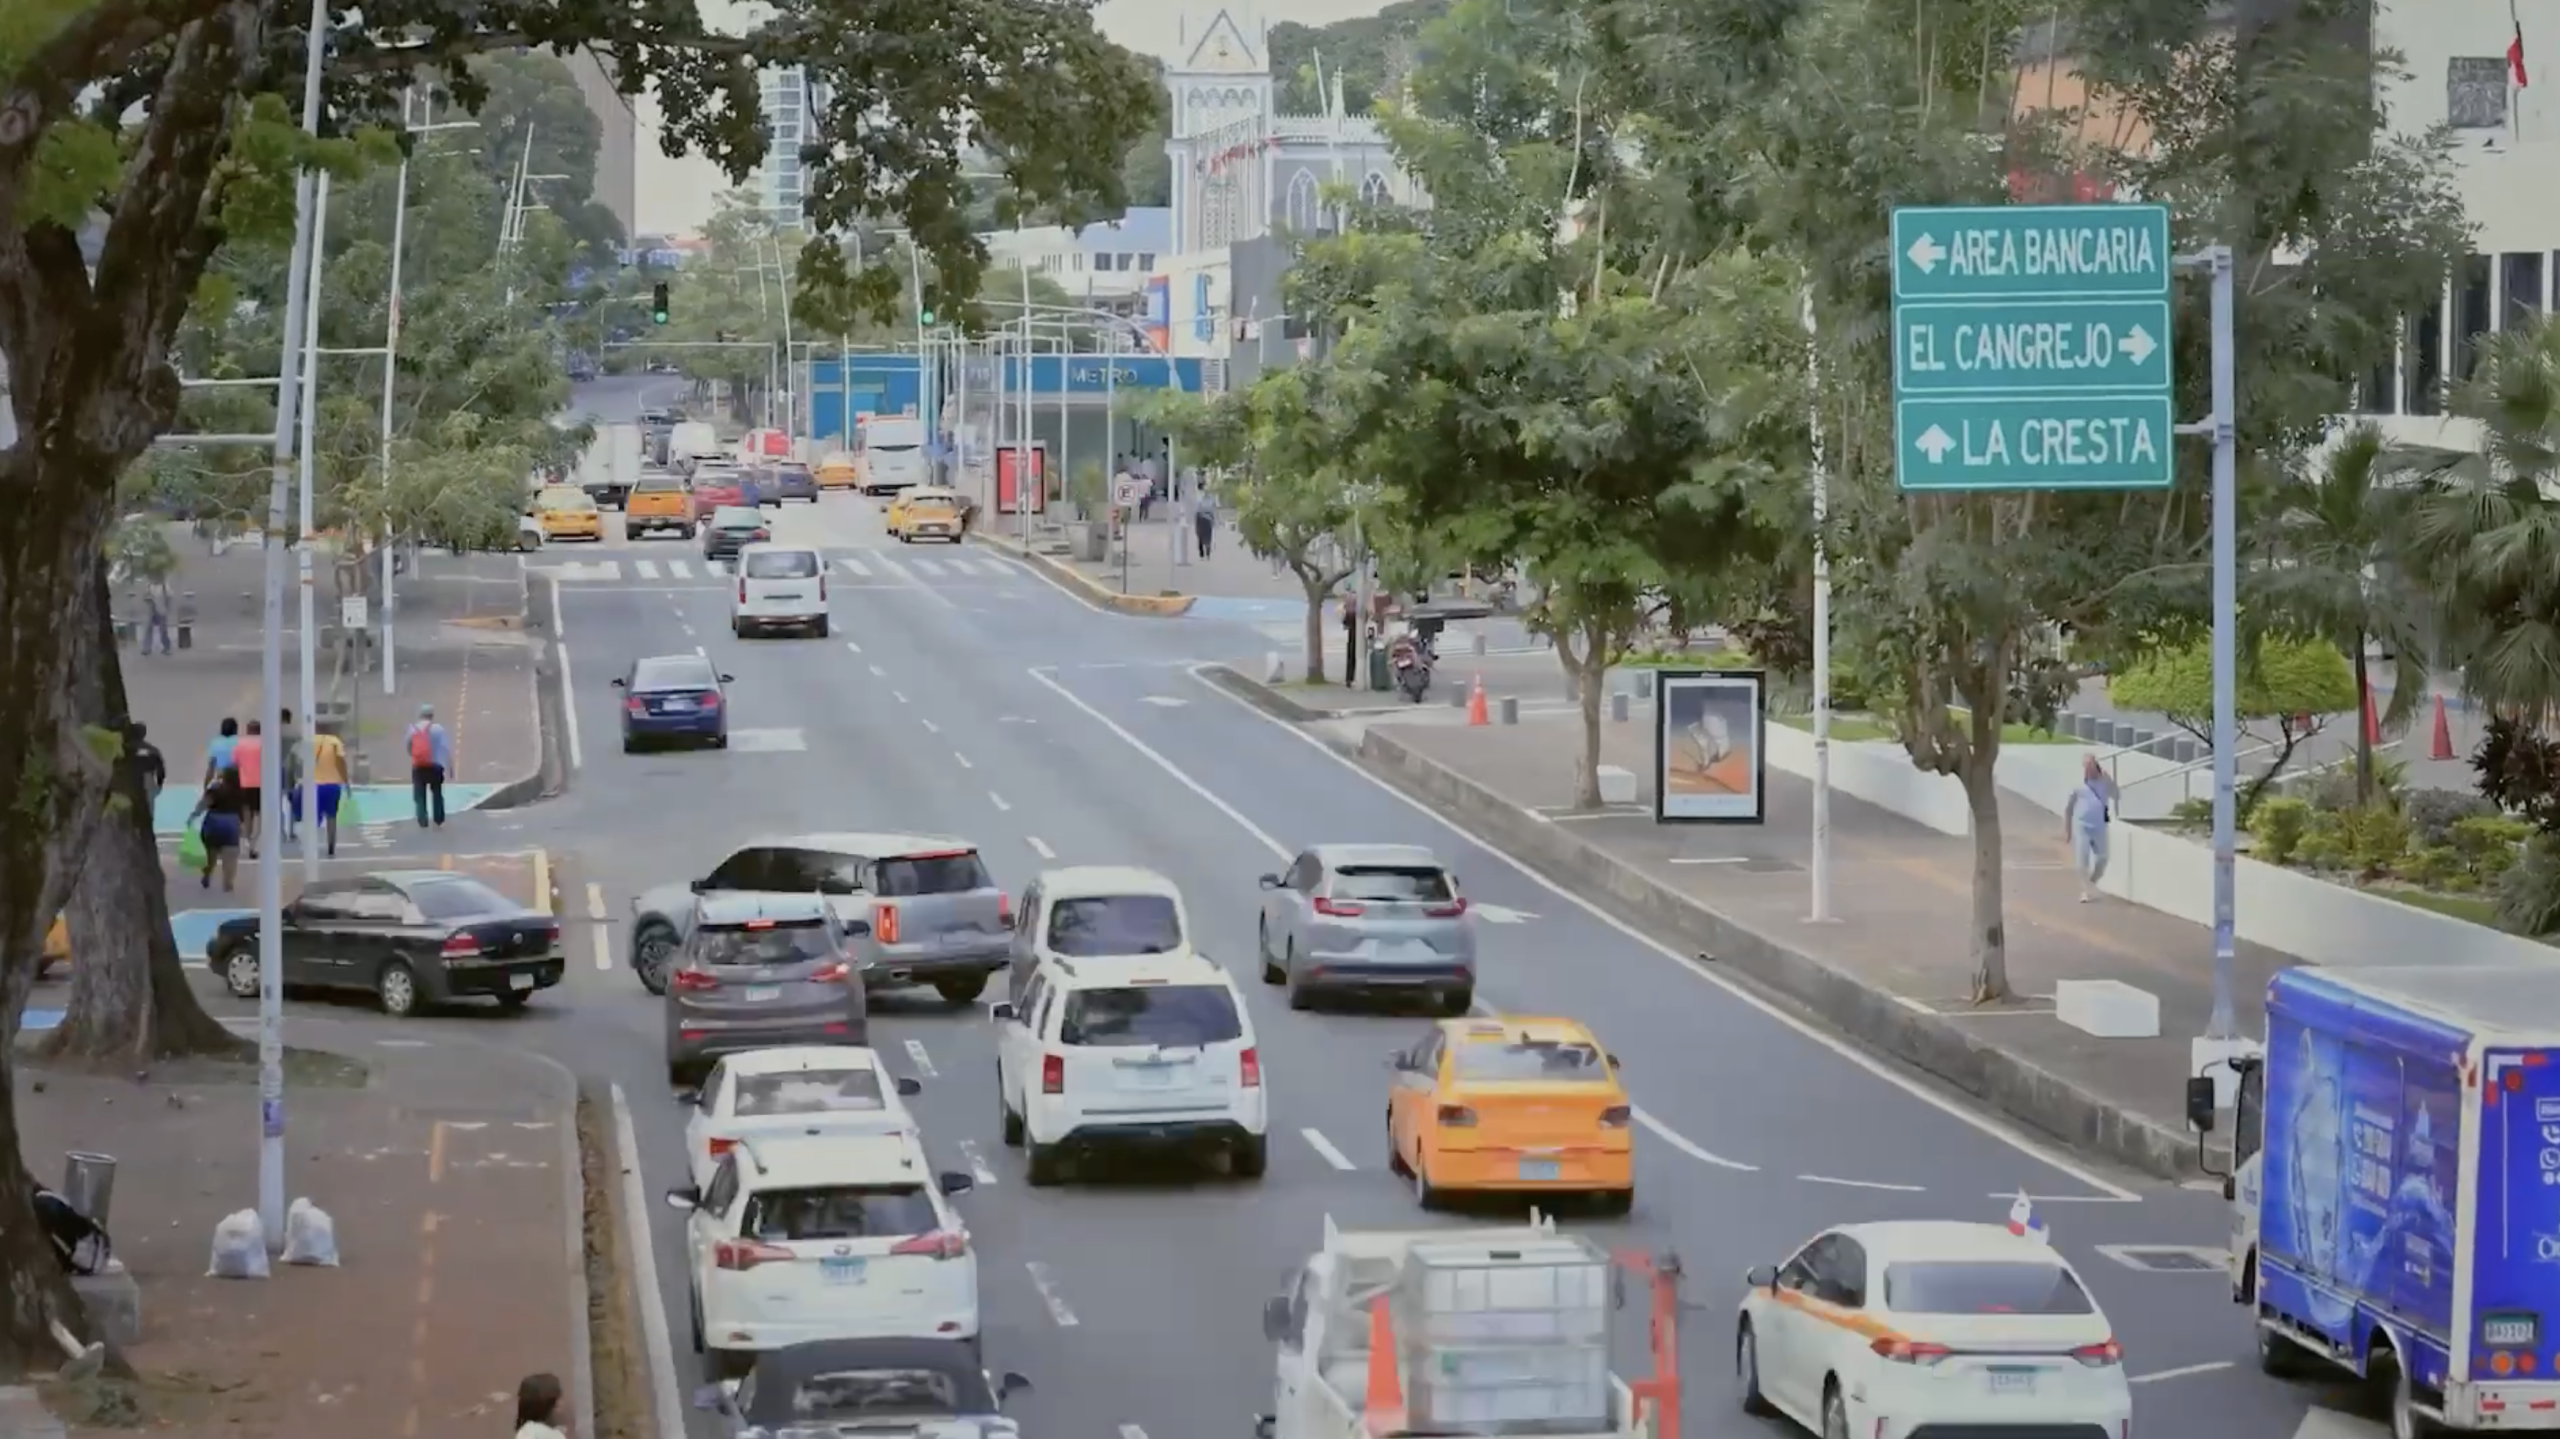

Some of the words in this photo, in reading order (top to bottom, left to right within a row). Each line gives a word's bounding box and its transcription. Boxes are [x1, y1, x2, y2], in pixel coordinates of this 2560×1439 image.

[1950, 229, 2019, 276] AREA
[2024, 226, 2156, 275] BANCARIA
[1909, 324, 1946, 371] EL
[1955, 322, 2113, 371] CANGREJO
[1070, 367, 1138, 384] METRO
[1963, 419, 2010, 466] LA
[2020, 417, 2156, 465] CRESTA
